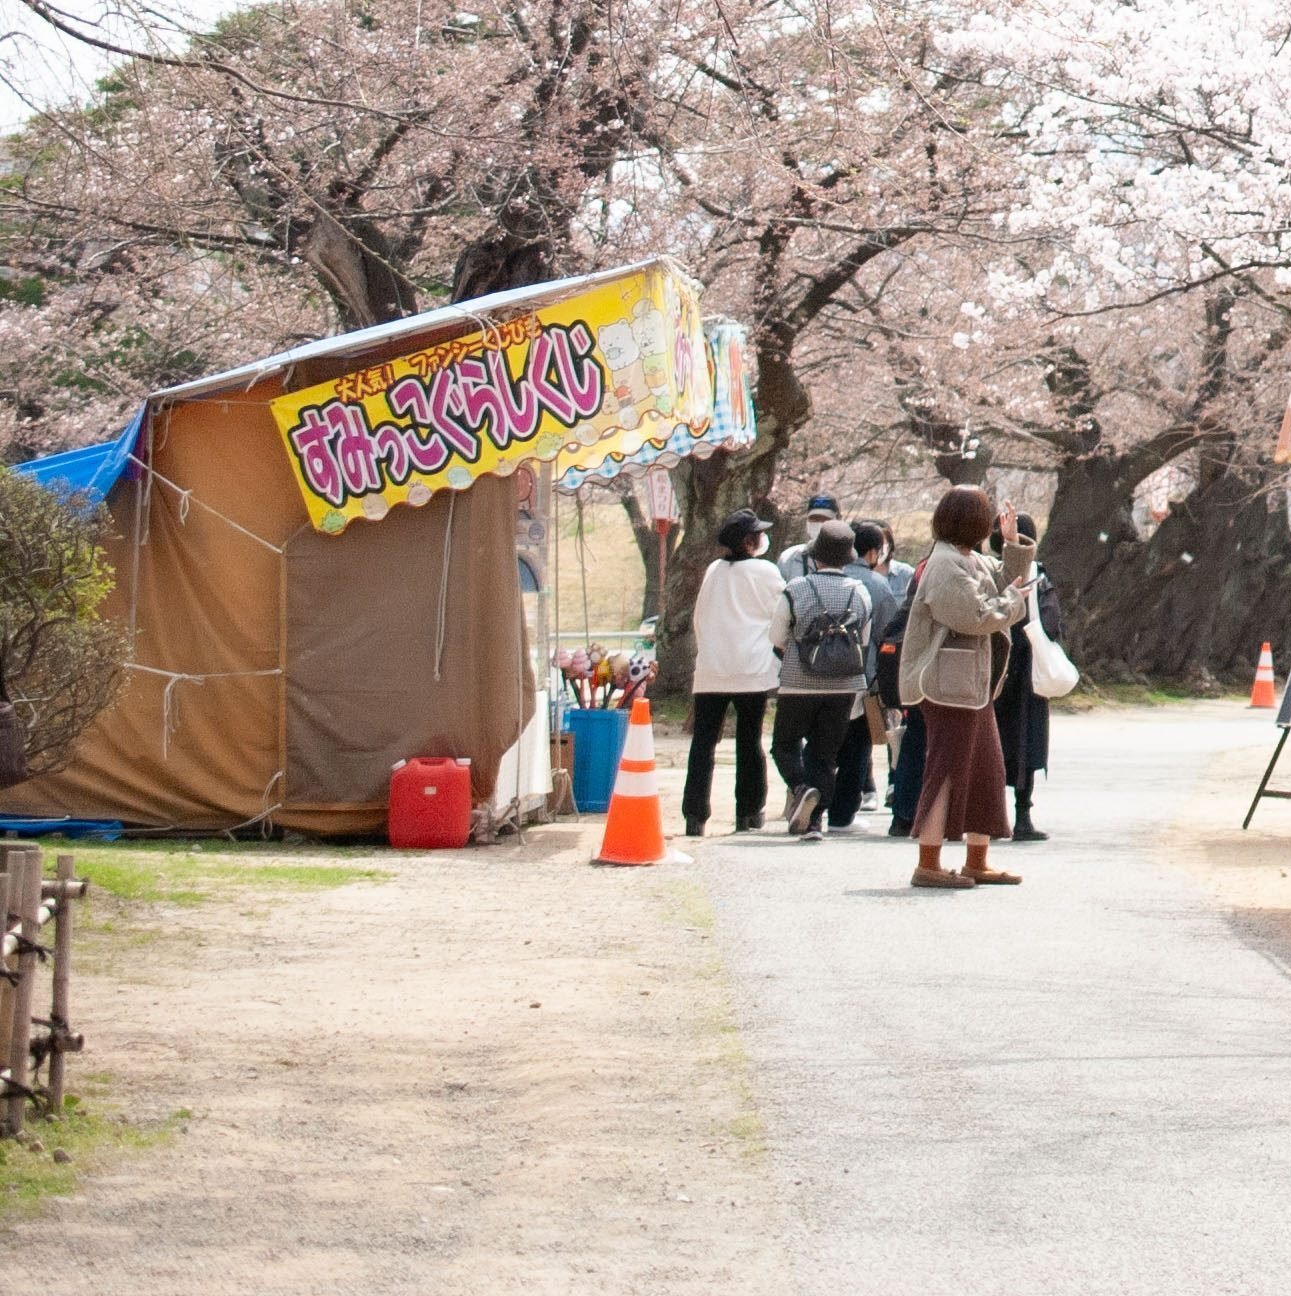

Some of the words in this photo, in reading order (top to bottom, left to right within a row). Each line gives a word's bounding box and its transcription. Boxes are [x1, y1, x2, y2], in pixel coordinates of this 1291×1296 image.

[287, 318, 606, 507] すみっこぐらしくじ
